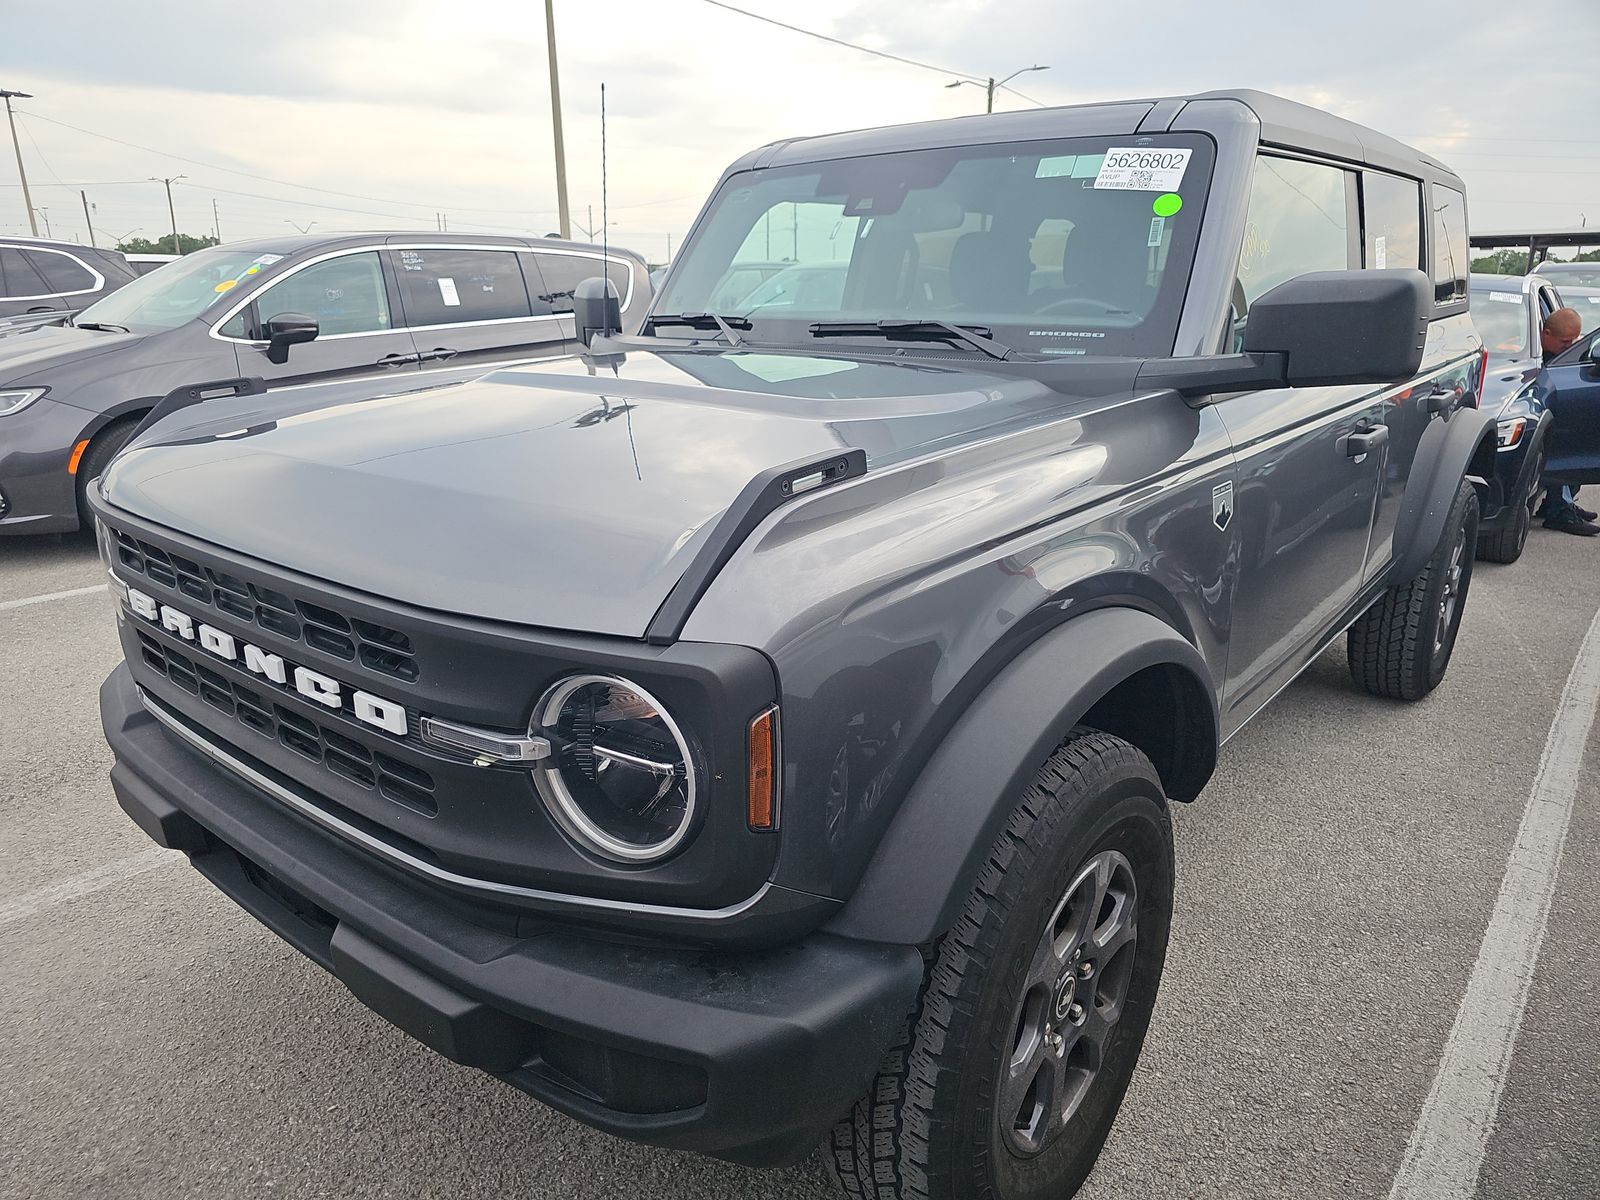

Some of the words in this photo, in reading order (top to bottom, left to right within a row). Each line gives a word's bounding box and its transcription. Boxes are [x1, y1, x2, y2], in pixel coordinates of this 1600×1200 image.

[1107, 152, 1184, 169] 5626802
[1028, 330, 1106, 338] BRONCO
[129, 588, 408, 736] BRONCO
